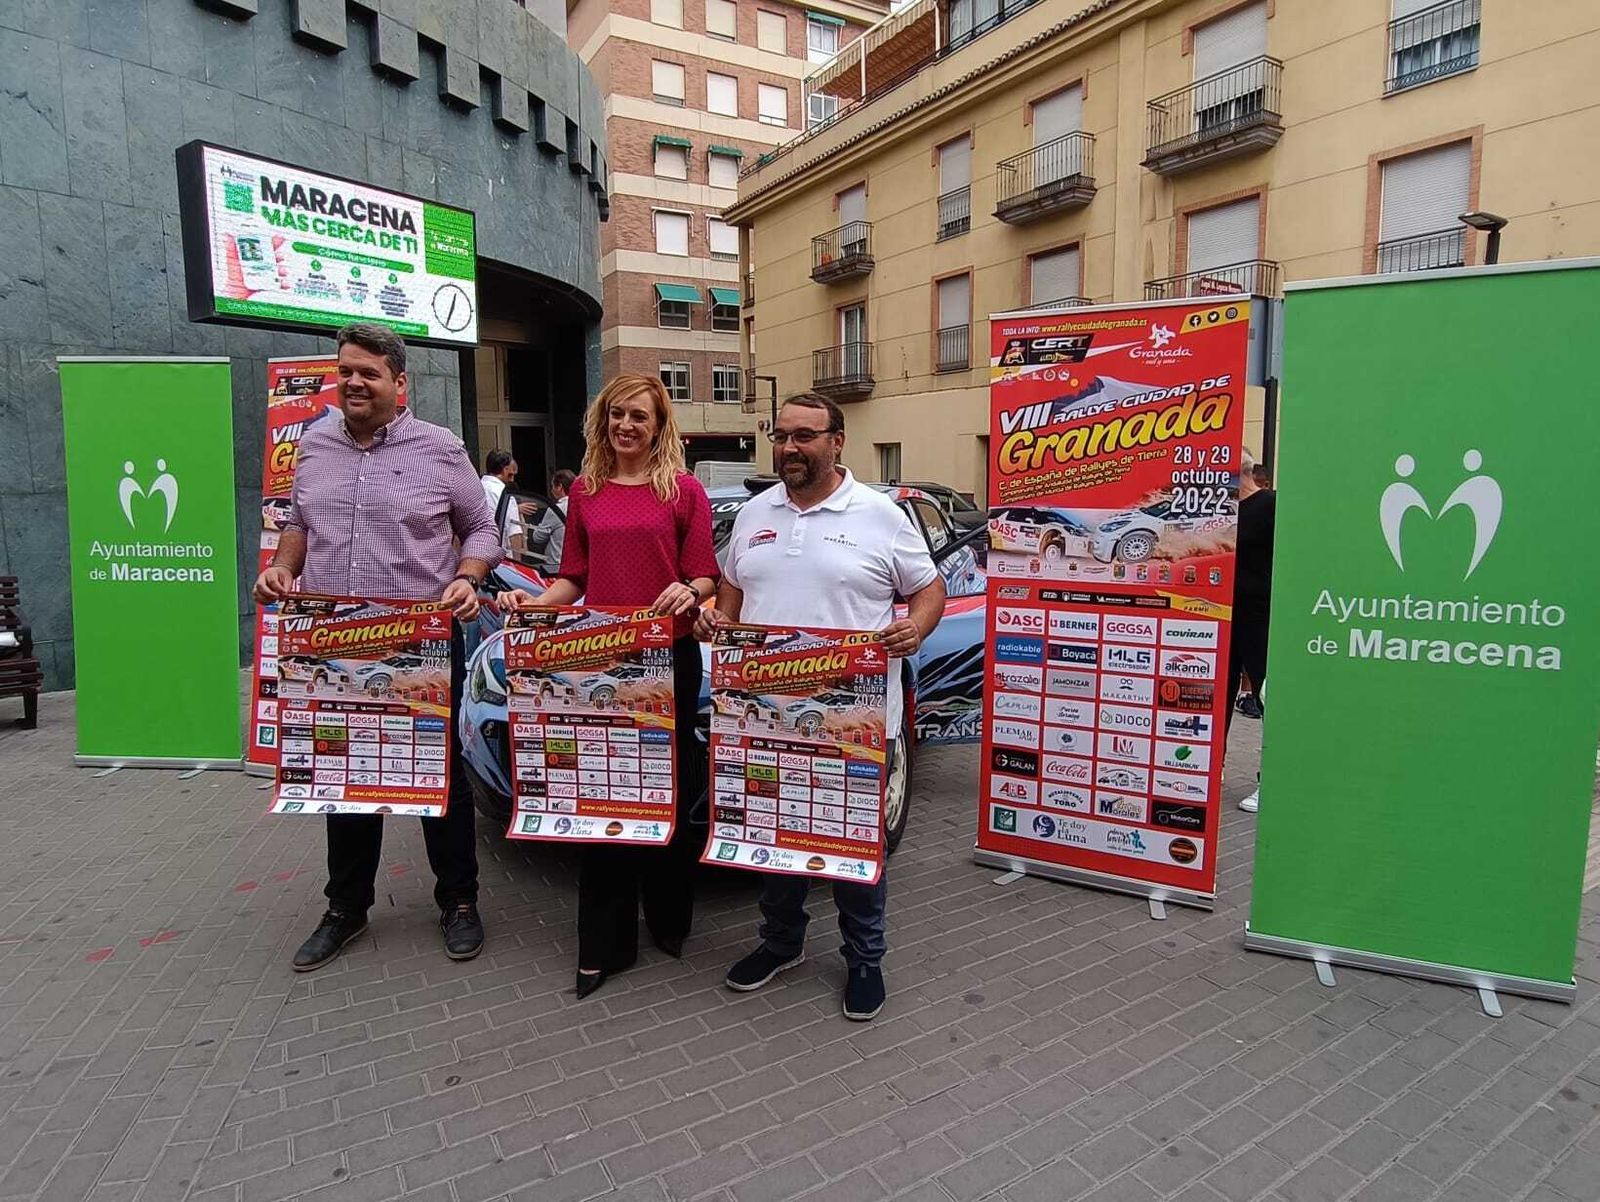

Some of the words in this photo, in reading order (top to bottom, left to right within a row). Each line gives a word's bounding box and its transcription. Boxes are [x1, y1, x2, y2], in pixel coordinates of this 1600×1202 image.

[260, 175, 417, 235] MARACENA
[312, 217, 376, 246] CERCA
[379, 231, 401, 250] DE
[402, 236, 418, 254] TI
[1129, 345, 1193, 359] Granada
[1000, 401, 1052, 434] VIII
[1053, 400, 1116, 424] RALLYE
[1120, 384, 1195, 408] CIUDAD
[1200, 374, 1231, 392] DE
[999, 392, 1232, 474] Granada
[1173, 446, 1191, 464] 28
[1196, 450, 1206, 467] y
[1210, 445, 1230, 463] 29
[1009, 479, 1022, 488] de
[1024, 469, 1062, 485] España
[1065, 466, 1077, 476] de
[1080, 459, 1117, 473] Rallyes
[1121, 454, 1134, 464] de
[1138, 449, 1167, 461] Tierra
[1171, 468, 1230, 485] octubre
[1170, 487, 1229, 514] 2022
[90, 541, 213, 560] Ayuntamiento
[90, 568, 107, 580] de
[111, 563, 214, 582] Maracena
[1311, 589, 1565, 627] Ayuntamiento
[284, 616, 314, 633] VIII
[354, 610, 393, 620] CIUDAD
[395, 607, 409, 615] DE
[1011, 615, 1042, 627] ASC
[1059, 620, 1097, 631] BERNER
[310, 618, 416, 649] Granada
[509, 630, 536, 647] VIII
[576, 618, 613, 631] CIUDAD
[616, 615, 631, 623] DE
[534, 625, 637, 662] Granada
[717, 649, 744, 665] VIII
[785, 642, 824, 653] CIUDAD
[826, 638, 843, 646] DE
[997, 643, 1041, 653] radiokable
[1307, 635, 1338, 655] de
[1349, 628, 1562, 670] Maracena
[420, 649, 447, 657] octubre
[421, 656, 447, 669] 2022
[741, 648, 850, 682] Granada
[1165, 661, 1209, 674] alkamel
[643, 666, 670, 679] 2022
[853, 684, 884, 693] octubre
[1102, 692, 1150, 701] MAKARTHY
[854, 694, 883, 708] 2022
[1115, 714, 1151, 727] DIOCO
[725, 749, 742, 757] ASC
[1009, 760, 1034, 770] GALAN
[1054, 799, 1076, 808] TORO
[1059, 819, 1067, 827] Te
[1070, 820, 1087, 831] doy
[1057, 830, 1086, 843] Luna
